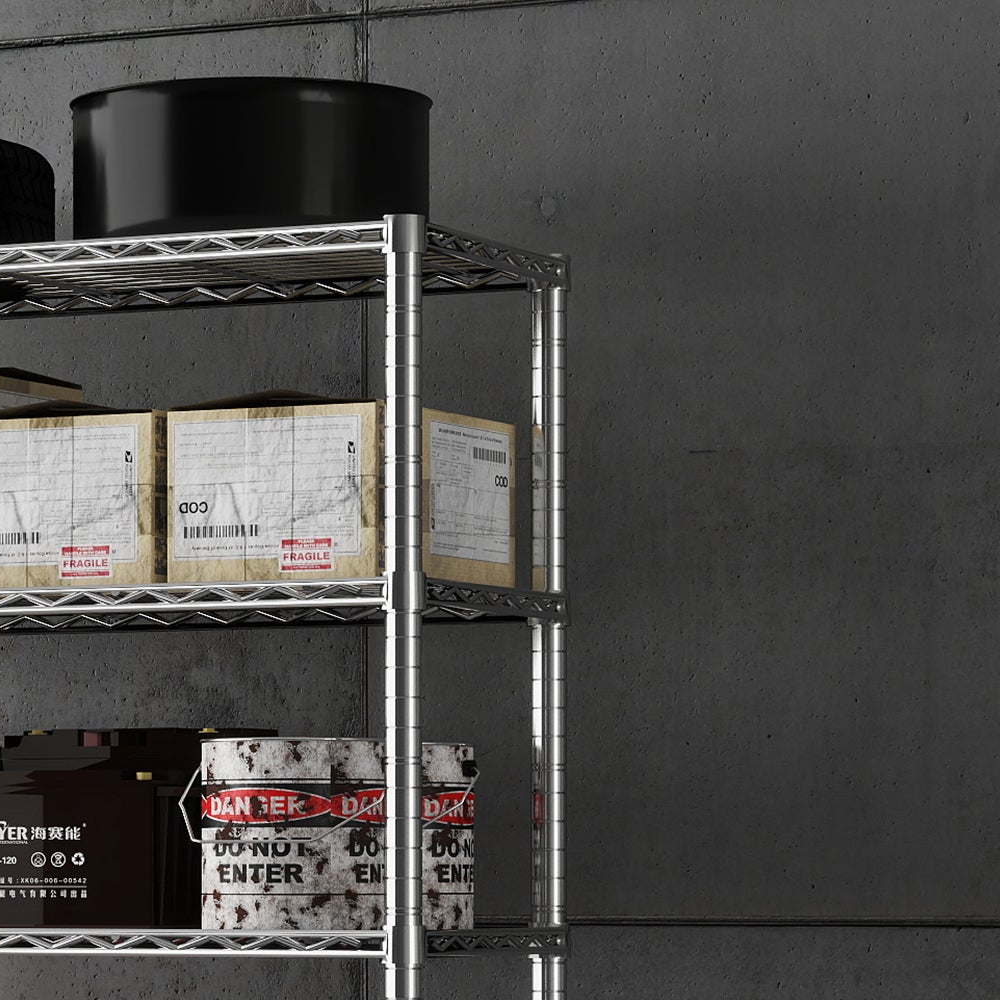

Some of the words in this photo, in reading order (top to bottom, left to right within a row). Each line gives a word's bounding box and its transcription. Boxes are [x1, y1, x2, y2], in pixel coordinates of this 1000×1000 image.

[179, 501, 208, 514] COD
[63, 559, 108, 568] FRAGILE
[283, 552, 330, 561] FRAGILE
[342, 797, 382, 815] DAN
[215, 837, 242, 857] DO
[252, 837, 311, 857] NOT
[350, 837, 378, 857] DO
[432, 838, 459, 858] DO
[219, 864, 304, 883] ENTER
[356, 864, 384, 883] EN
